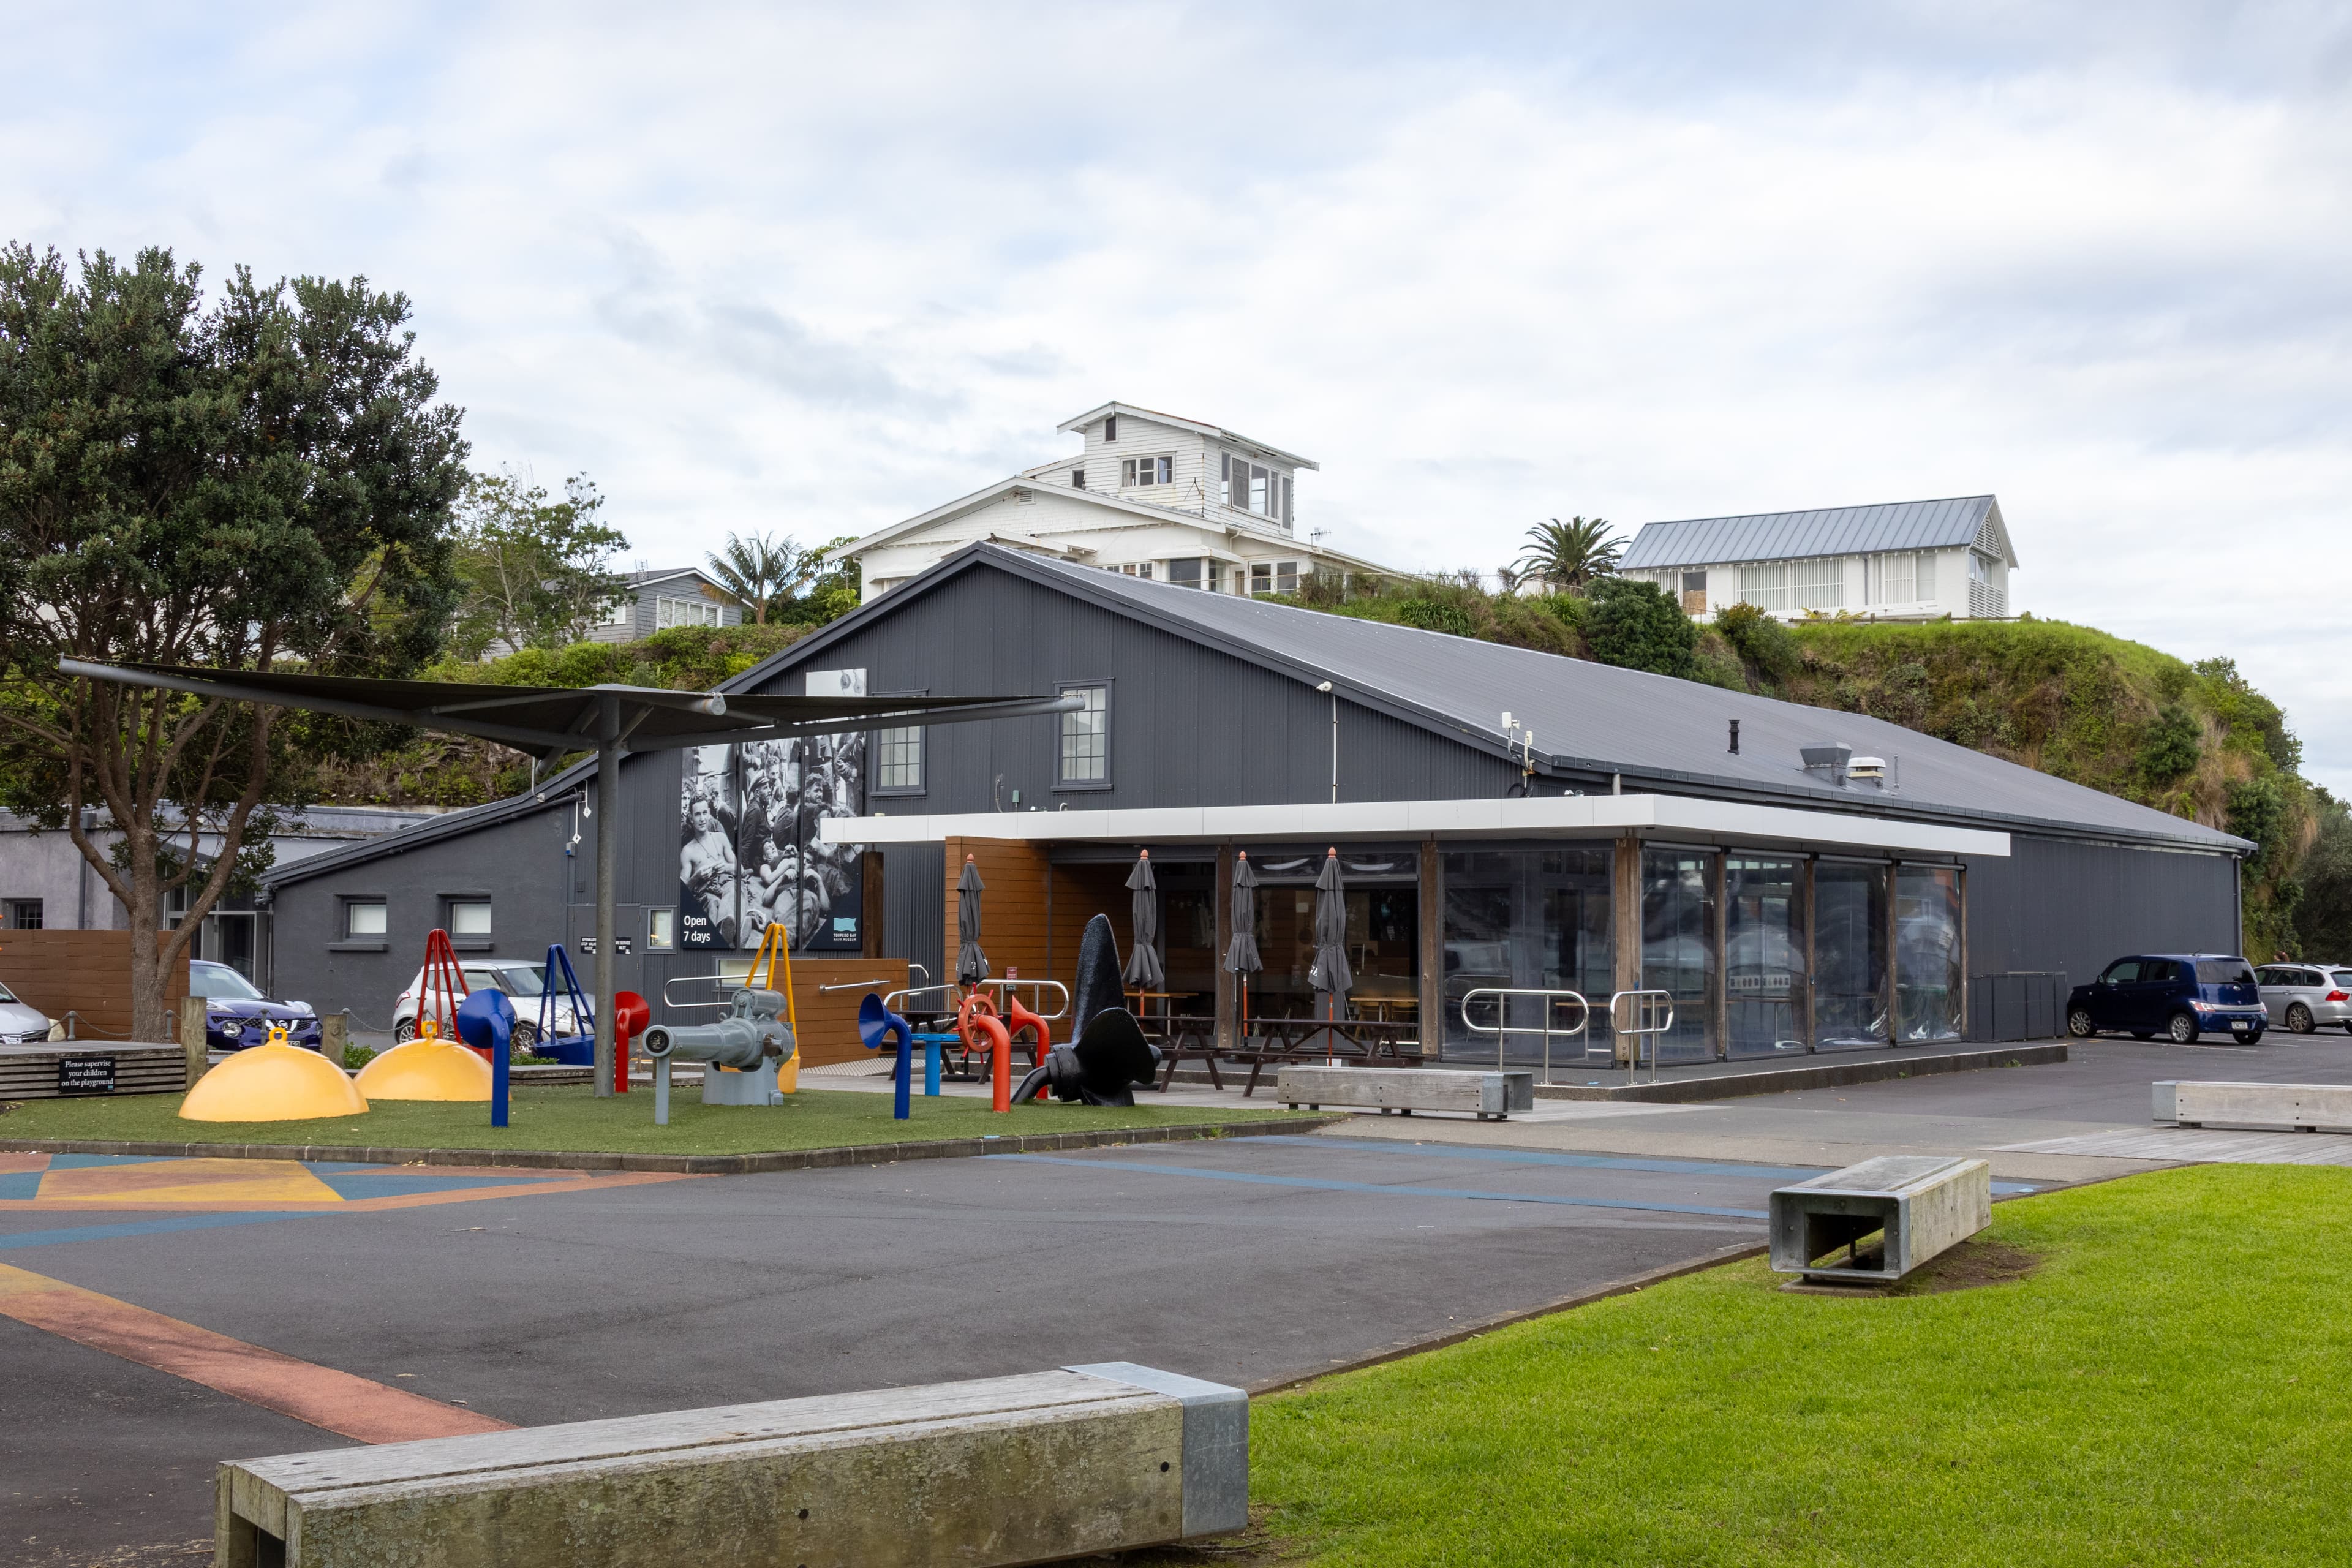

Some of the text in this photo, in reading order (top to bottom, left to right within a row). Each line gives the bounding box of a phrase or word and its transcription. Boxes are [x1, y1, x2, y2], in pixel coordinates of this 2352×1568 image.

[684, 915, 706, 927] Open
[684, 931, 710, 943] 7 days
[81, 1078, 113, 1087] playground
